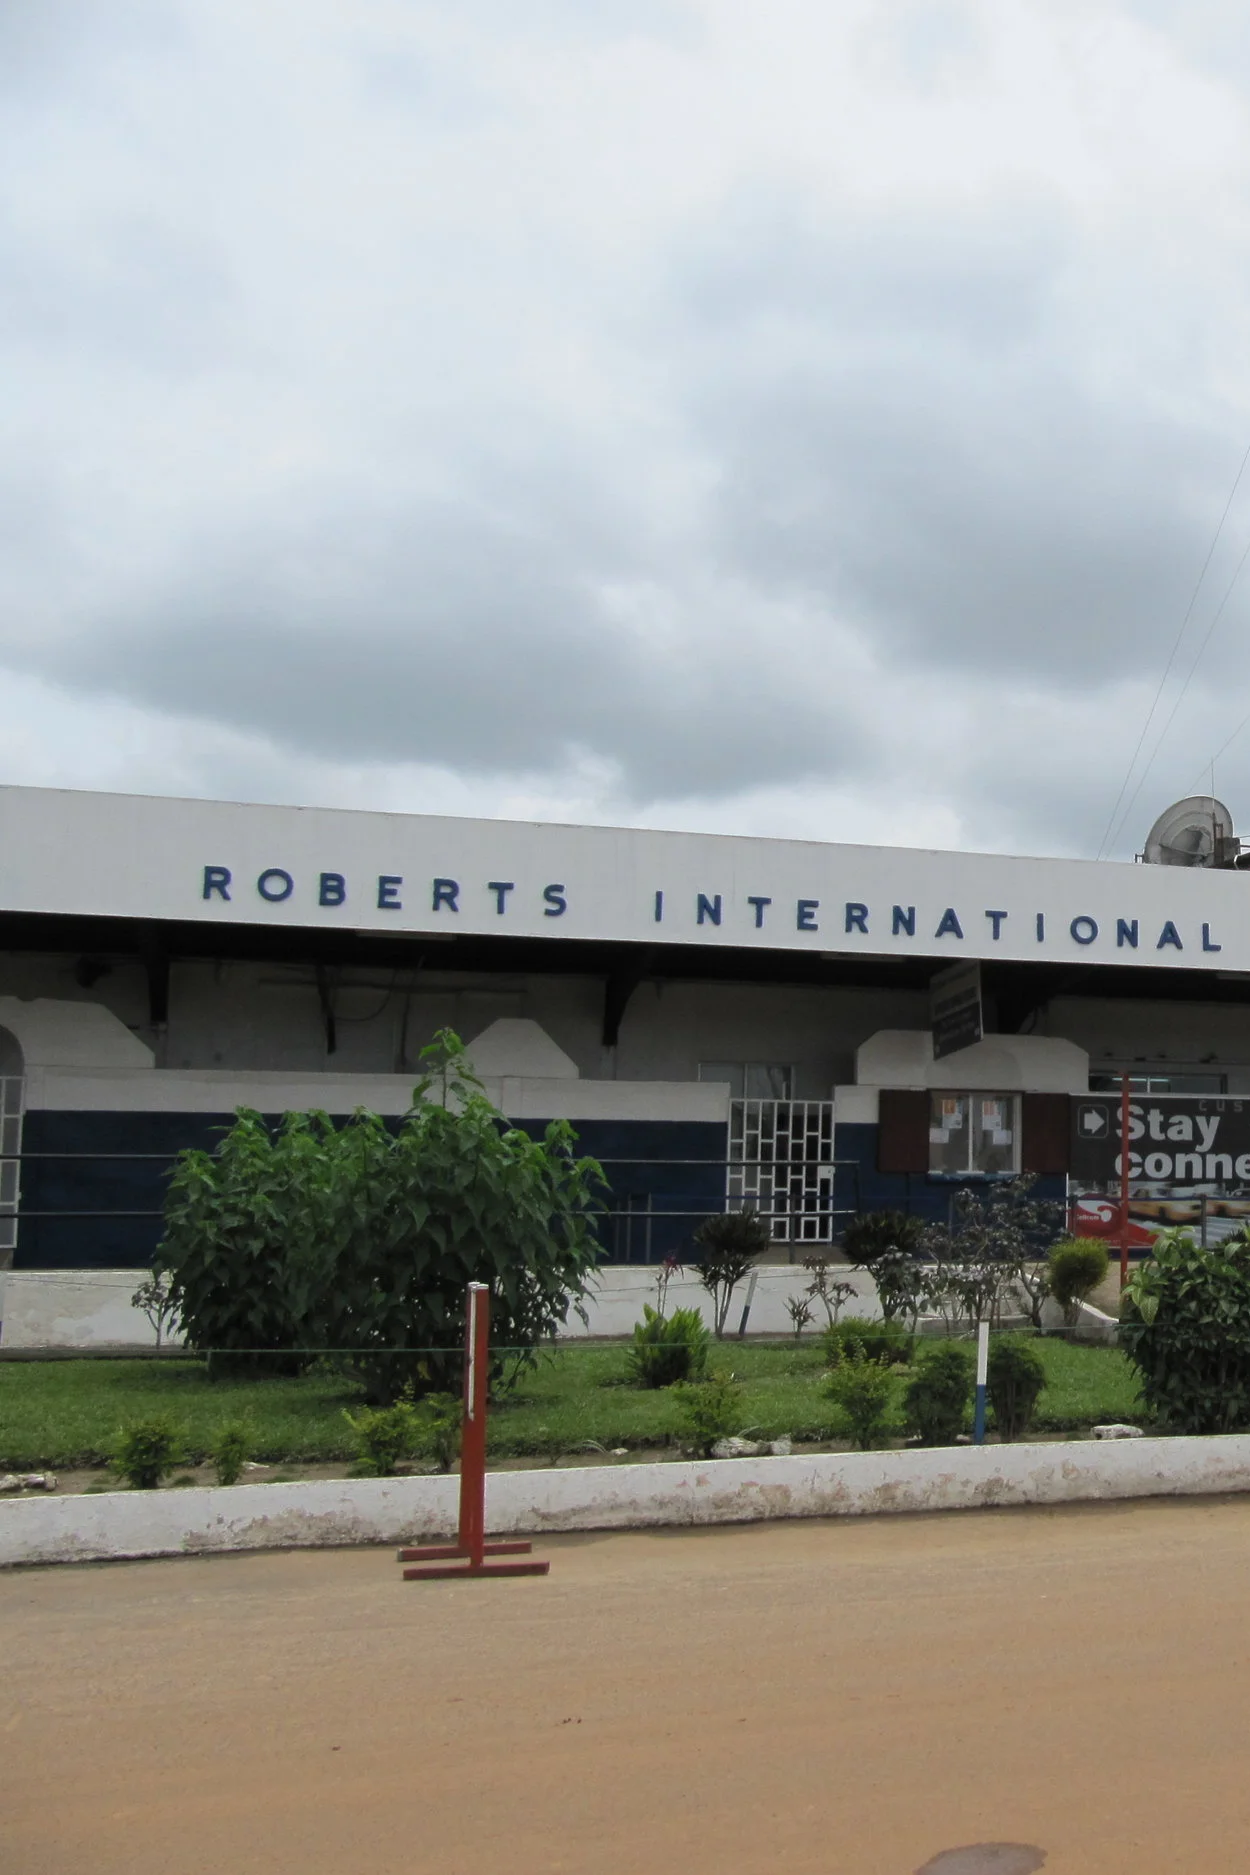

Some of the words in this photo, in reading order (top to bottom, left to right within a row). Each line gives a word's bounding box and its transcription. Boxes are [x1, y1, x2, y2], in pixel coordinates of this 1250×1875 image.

[203, 866, 567, 917] ROBERTS
[655, 890, 1222, 953] INTERNATIONAL
[1116, 1104, 1221, 1153] Stay
